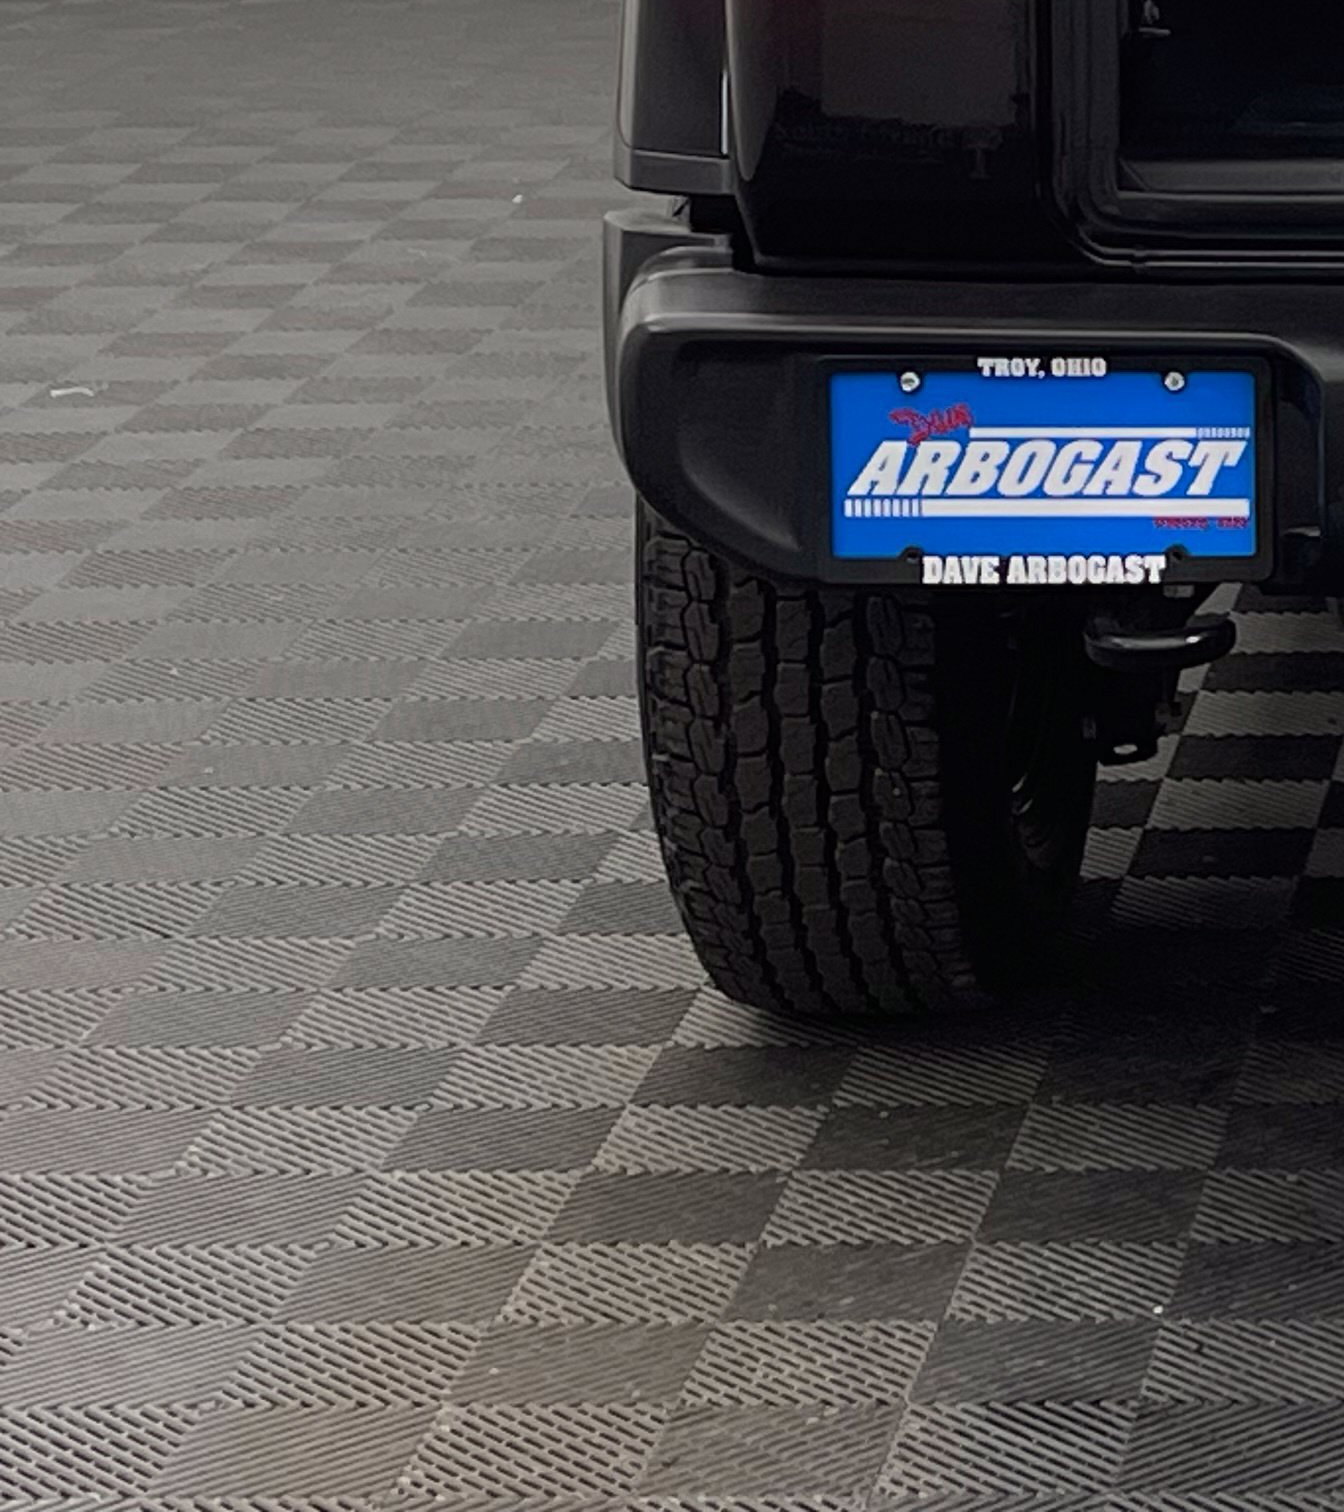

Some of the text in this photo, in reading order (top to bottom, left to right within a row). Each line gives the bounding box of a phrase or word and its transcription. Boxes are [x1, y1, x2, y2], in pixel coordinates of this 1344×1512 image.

[977, 356, 1108, 379] TROY, OHIO
[847, 439, 1248, 497] ARBOGAST
[921, 555, 1166, 585] DAVE ARBOGAST
